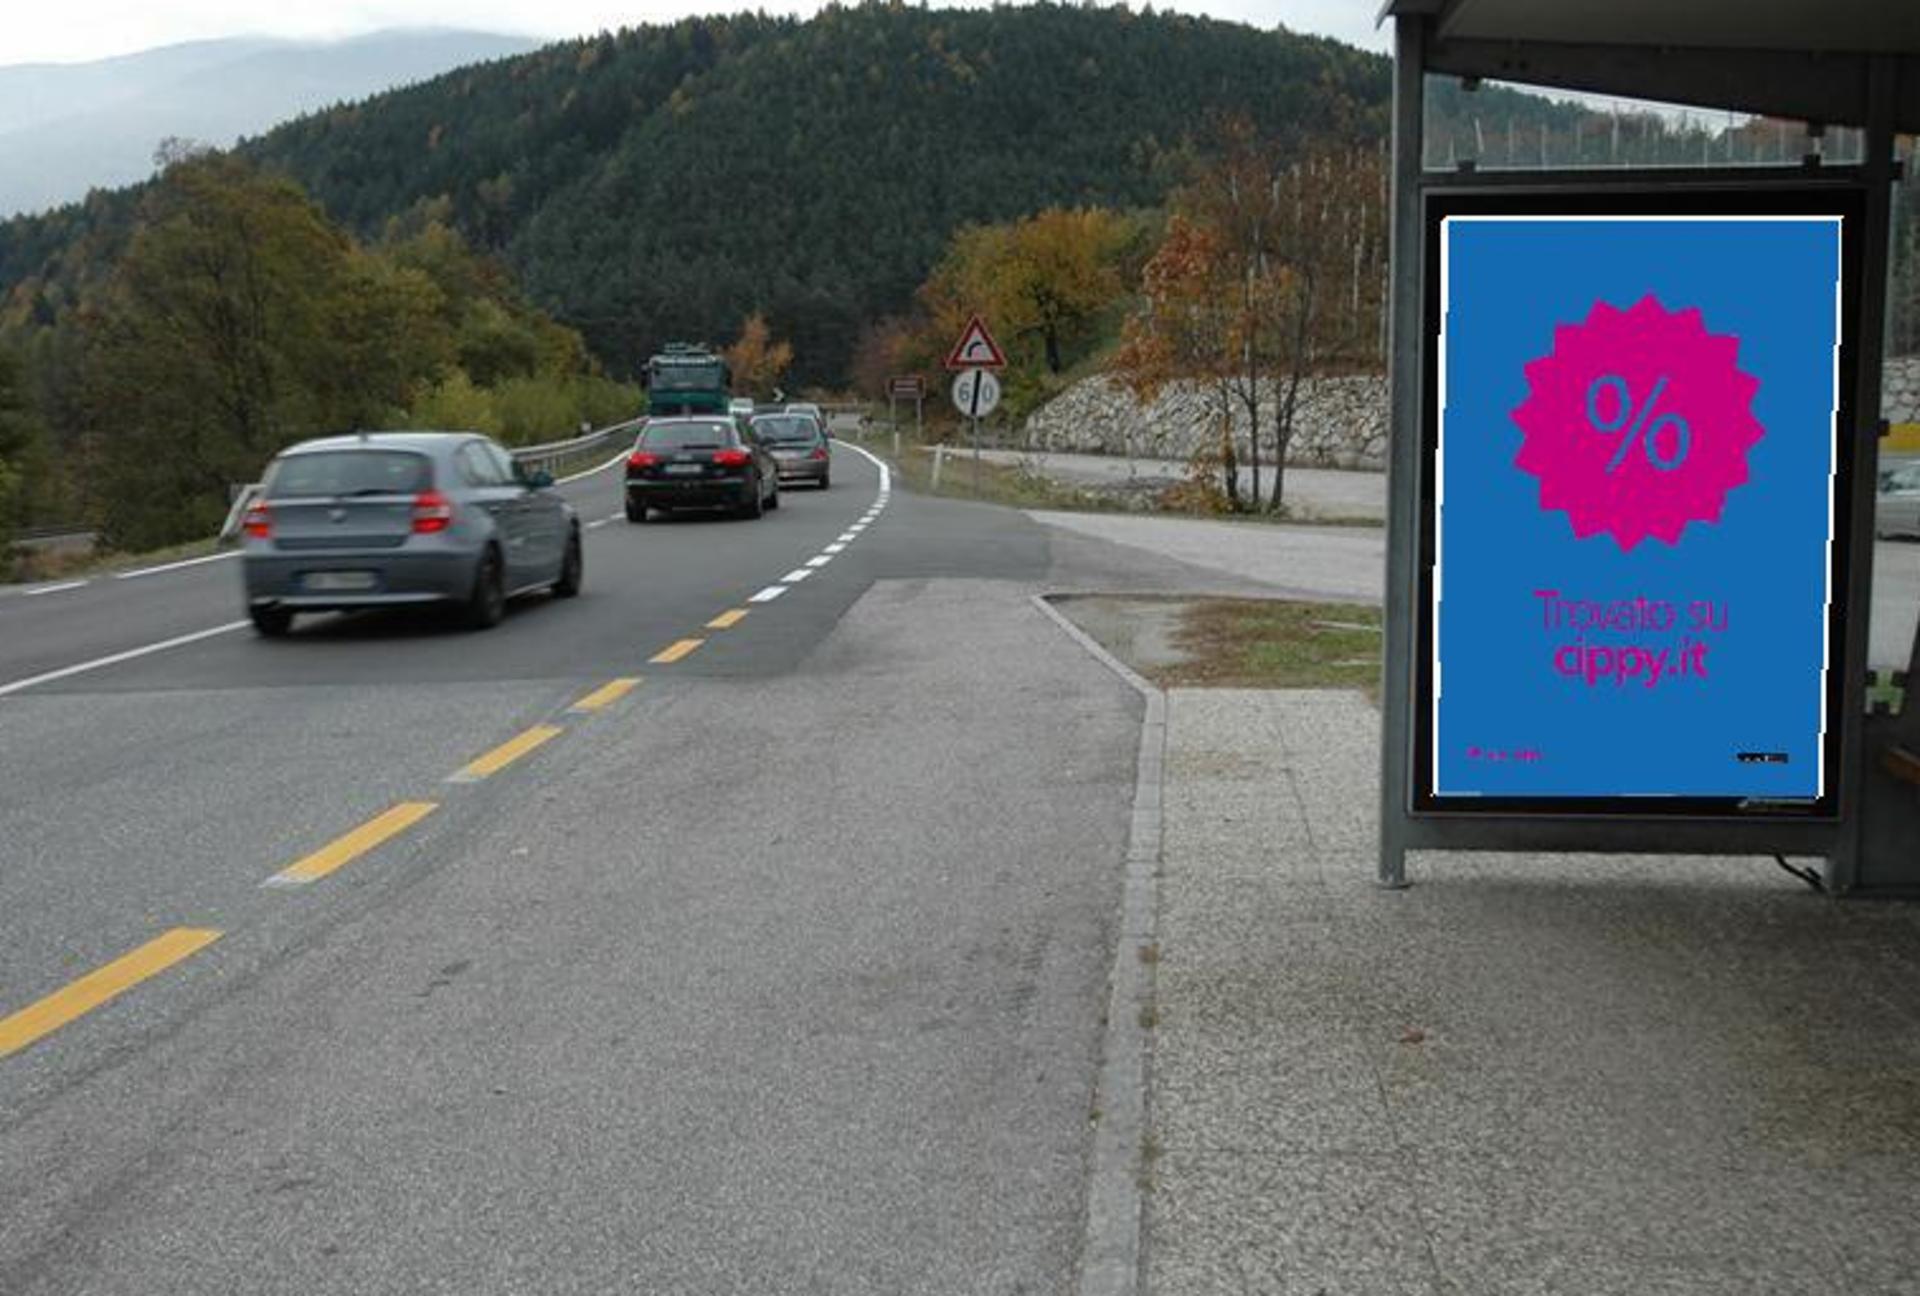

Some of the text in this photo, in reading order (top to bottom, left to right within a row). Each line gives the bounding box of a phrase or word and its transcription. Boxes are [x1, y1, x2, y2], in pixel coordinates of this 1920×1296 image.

[958, 382, 994, 402] 60
[1586, 374, 1690, 474] %
[1533, 589, 1729, 632] Trovato su
[1553, 636, 1709, 688] cippy.it
